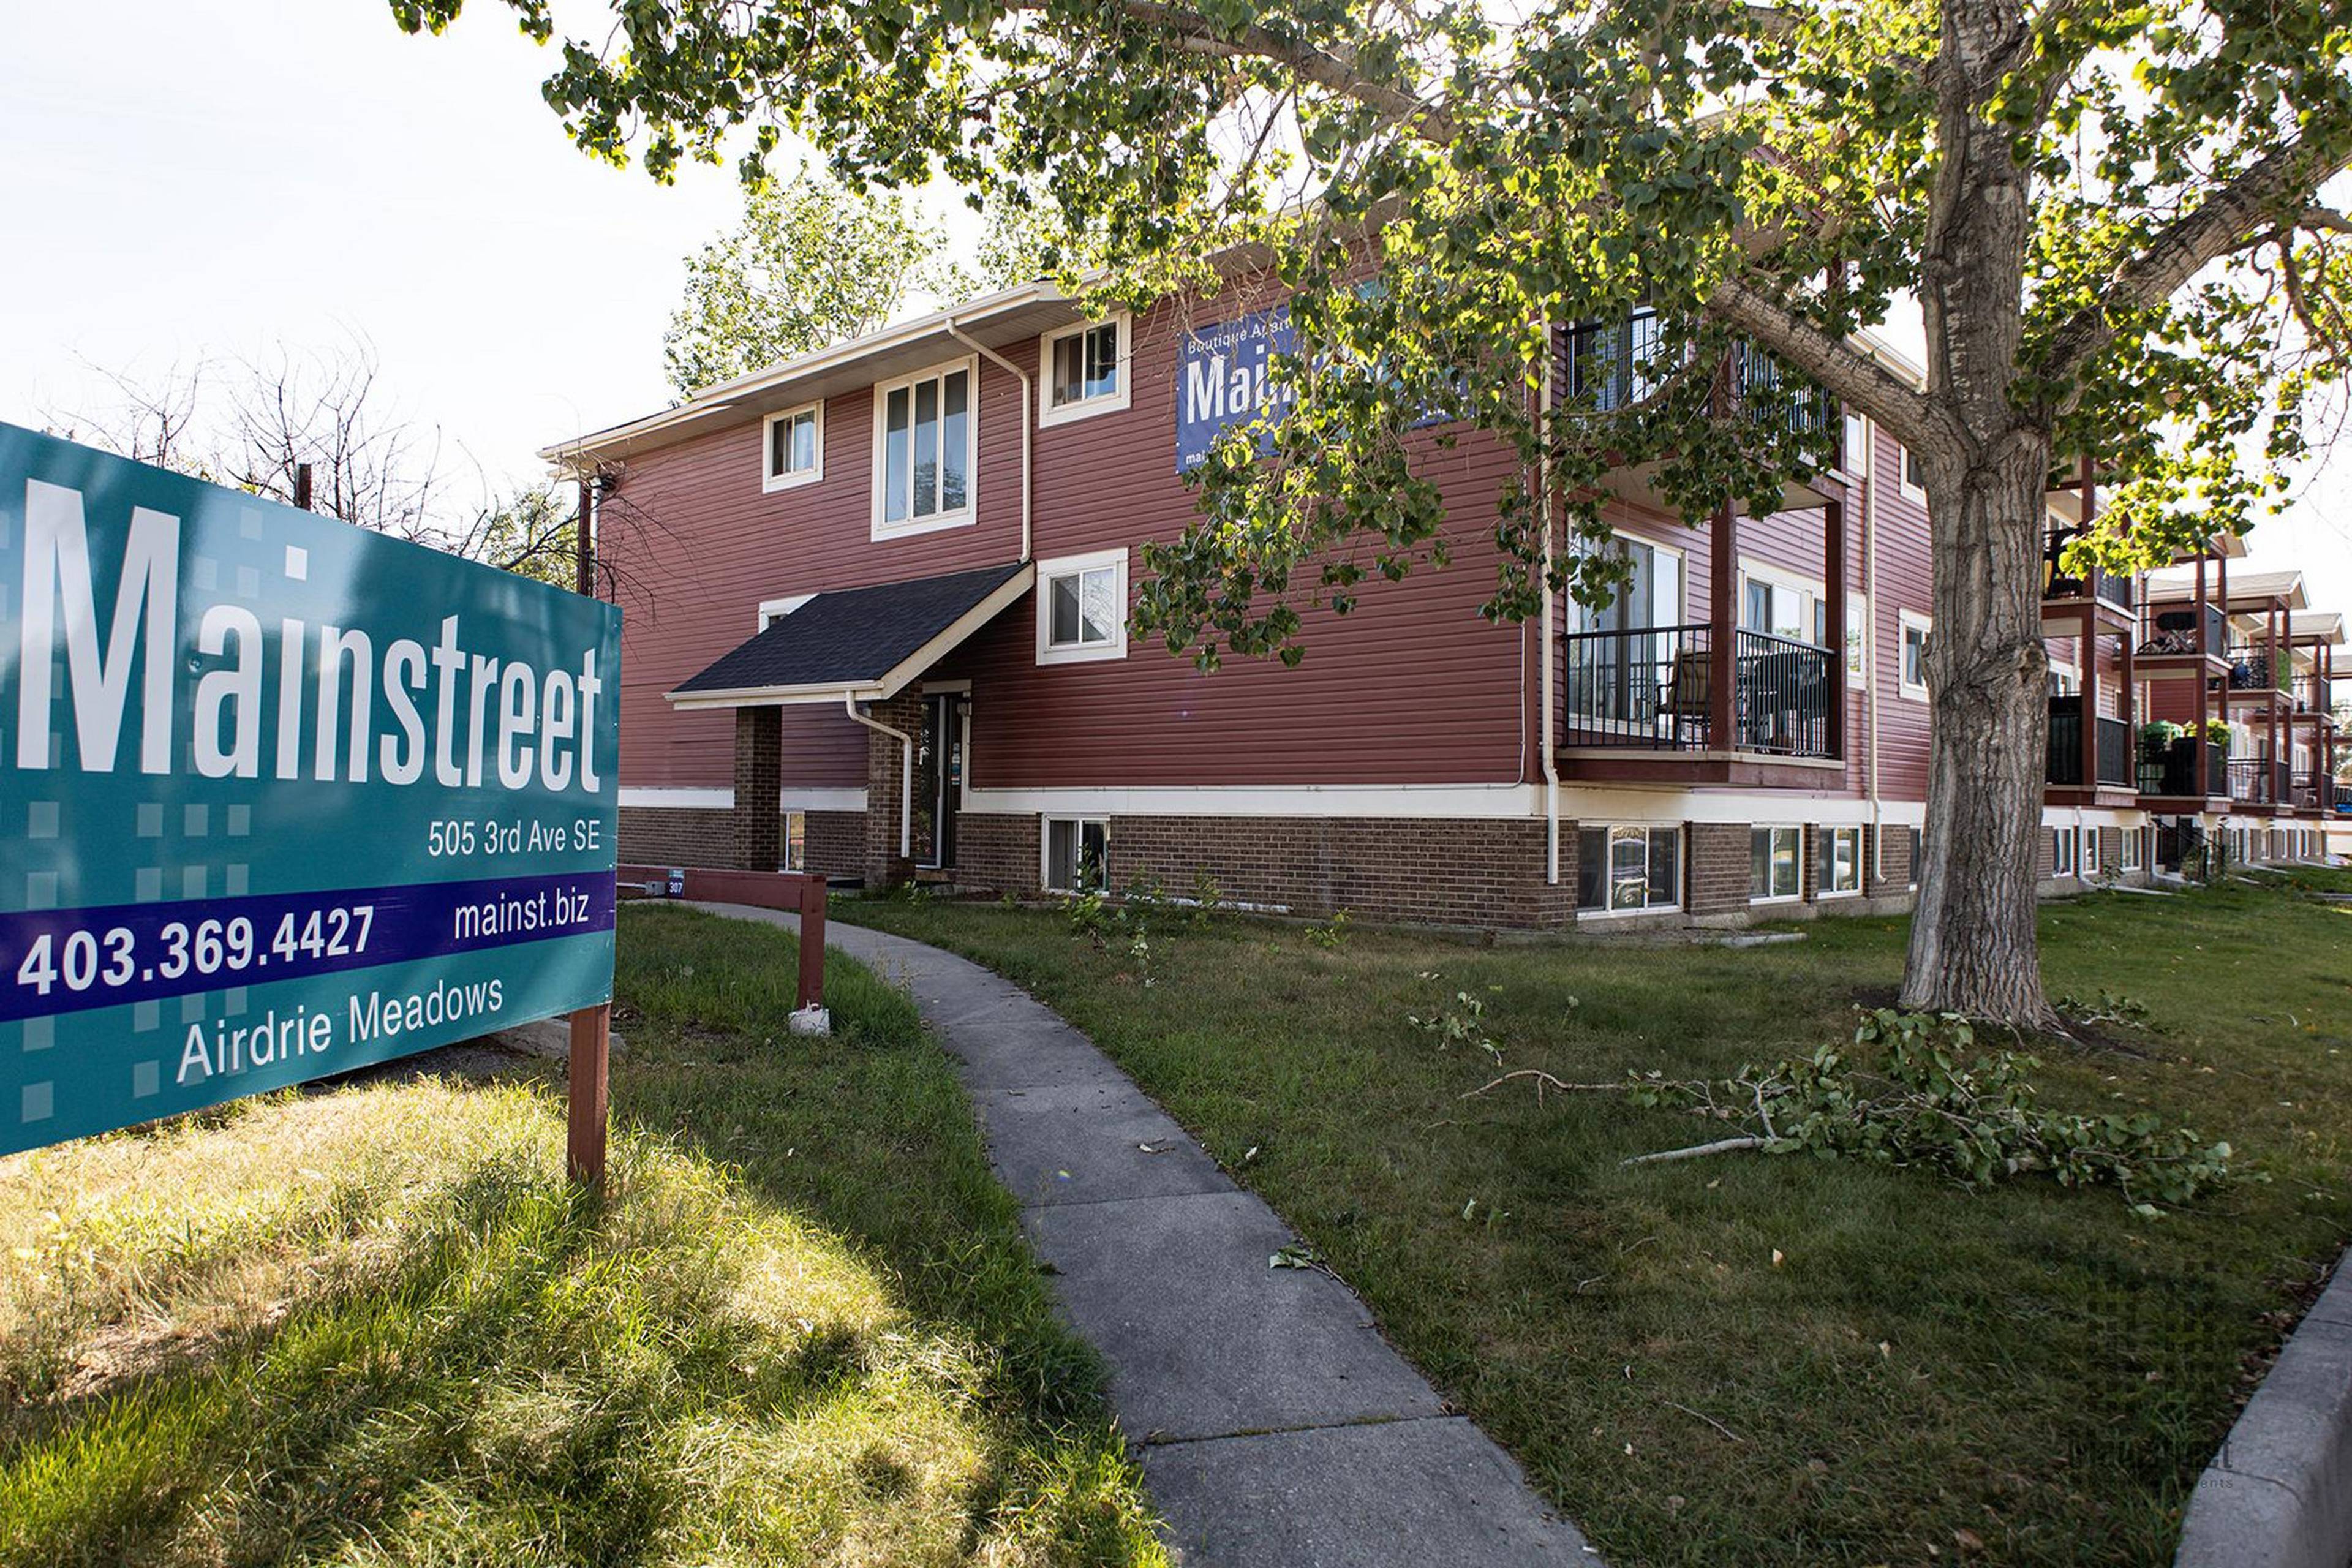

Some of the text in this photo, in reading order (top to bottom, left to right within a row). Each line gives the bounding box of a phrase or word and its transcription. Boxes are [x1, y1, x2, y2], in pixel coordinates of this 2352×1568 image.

[1188, 329, 1248, 354] Boutique
[17, 478, 601, 791] Mainstreet
[428, 819, 601, 856] 505 3rd Ave SE
[669, 881, 683, 894] 307
[17, 886, 589, 995] 403.369.4427 mainst.biz
[176, 978, 503, 1084] Airdrie Meadows
